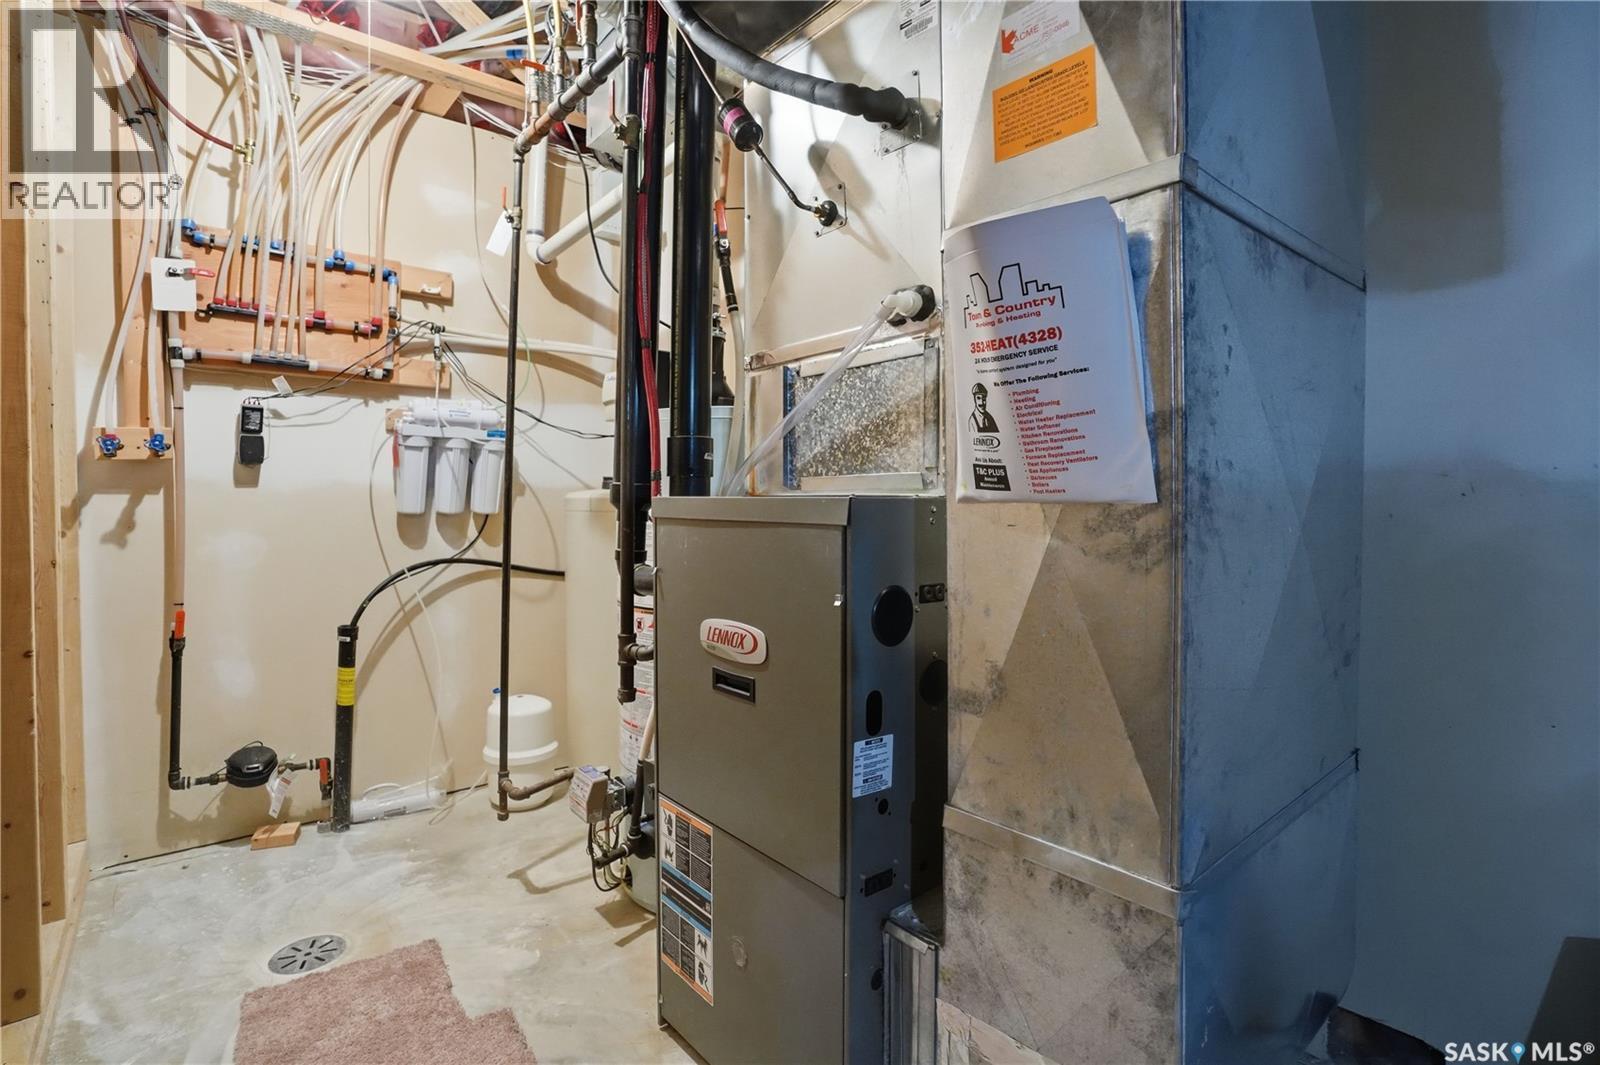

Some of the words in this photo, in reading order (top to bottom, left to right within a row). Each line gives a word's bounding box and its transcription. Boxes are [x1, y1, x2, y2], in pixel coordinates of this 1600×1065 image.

[983, 308, 992, 318] &
[994, 295, 1056, 315] Country
[1005, 310, 1041, 322] Heating
[970, 326, 1063, 354] 352-HEAT(4328)
[991, 351, 1027, 363] EMERGENCY
[1028, 344, 1059, 356] SERVICE
[1015, 360, 1038, 371] designed
[1027, 372, 1058, 382] Following
[1058, 366, 1090, 377] Services:
[1012, 388, 1040, 397] Plumbing
[1013, 396, 1037, 404] Heating
[1024, 399, 1061, 410] Conditioning
[1016, 410, 1043, 418] Electrical
[1035, 415, 1054, 423] Heater
[1055, 409, 1096, 420] Replacement
[1036, 422, 1061, 430] Softener
[1043, 427, 1078, 437] Renovations
[1022, 439, 1049, 447] Bathroom
[1049, 434, 1086, 443] Renovations
[1047, 449, 1086, 459] Replacement
[1065, 455, 1099, 464] Ventilators
[988, 468, 1005, 477] PLUS
[1039, 466, 1069, 474] Appliances
[706, 625, 748, 650] LENNOX
